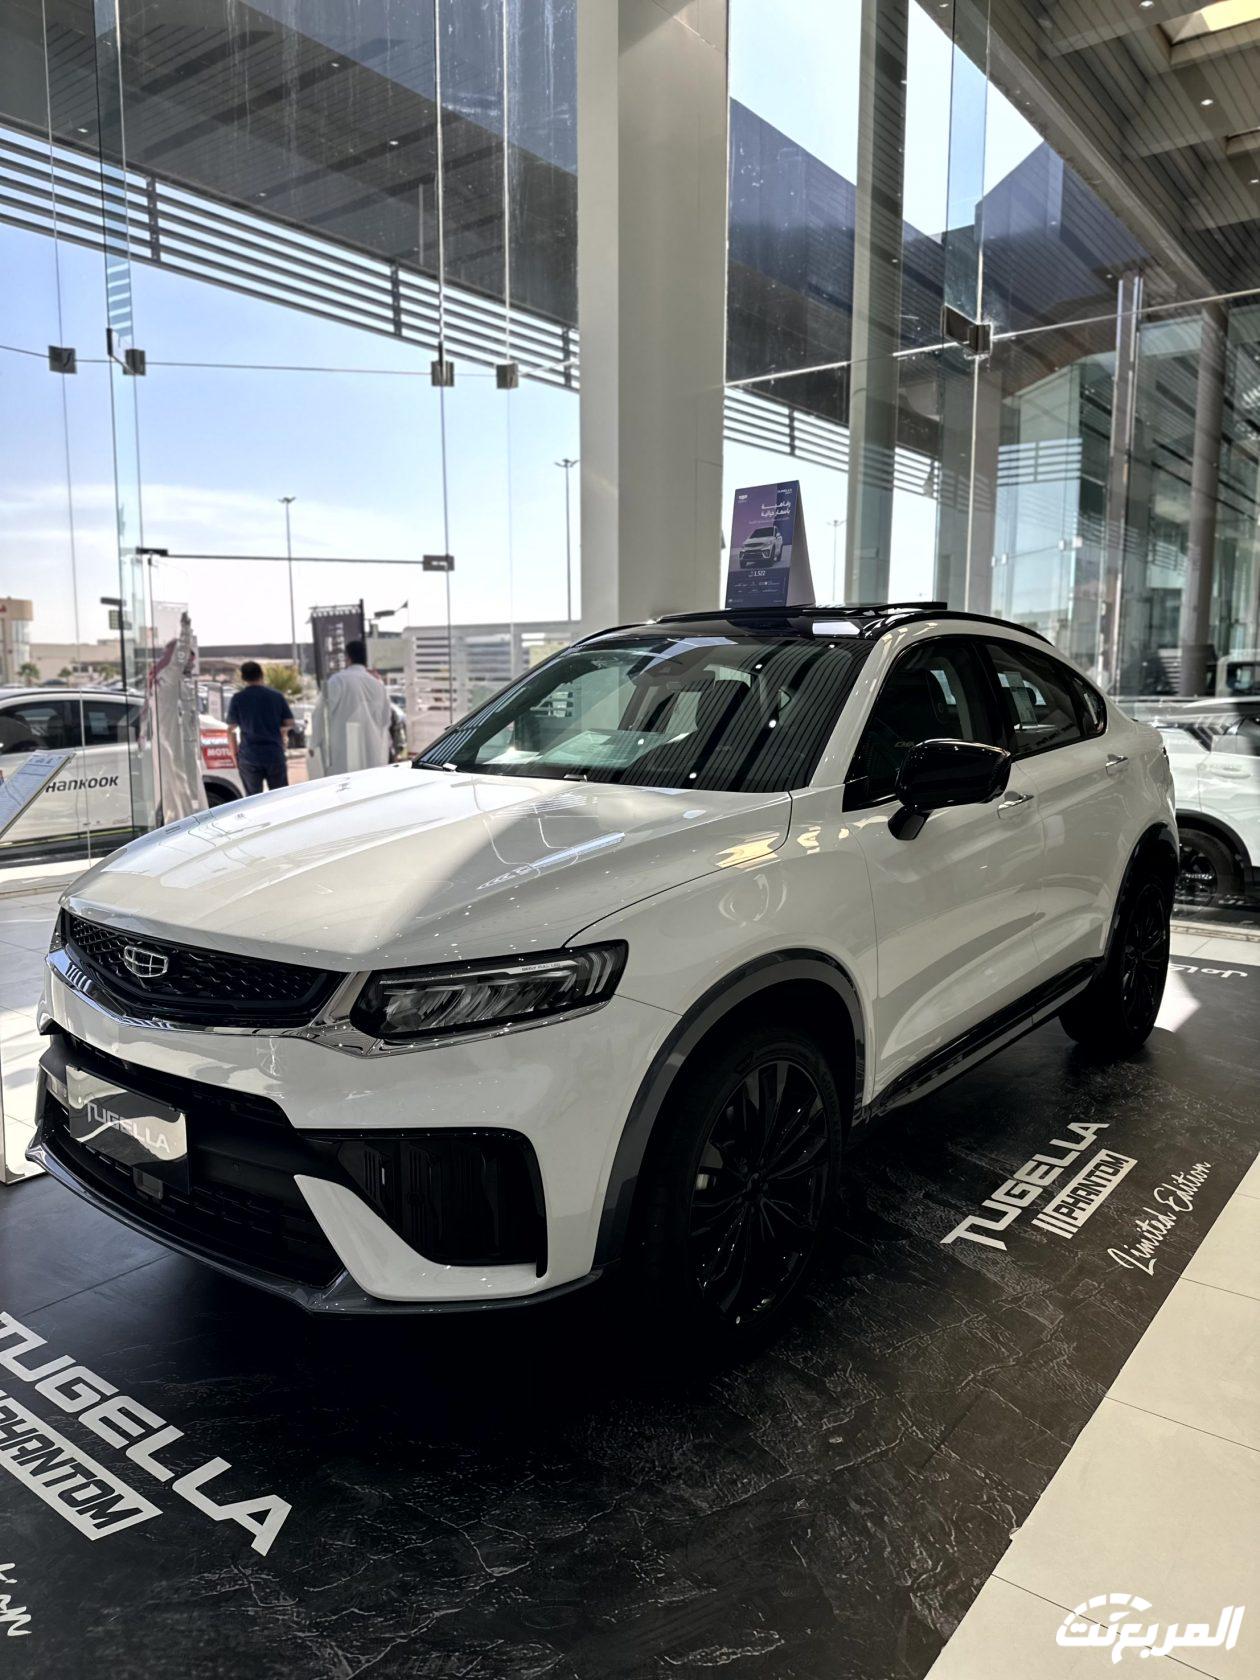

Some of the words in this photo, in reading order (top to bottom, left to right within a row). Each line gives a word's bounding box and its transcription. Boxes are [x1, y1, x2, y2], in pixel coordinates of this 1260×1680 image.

[207, 747, 232, 756] MOTU
[88, 1103, 170, 1153] TUGELLA
[940, 1122, 1110, 1251] TUGELLA
[1050, 1151, 1131, 1223] PHANTOM
[1107, 1207, 1177, 1276] Limited
[1153, 1160, 1213, 1212] Edition
[0, 1311, 292, 1556] TUGELLA
